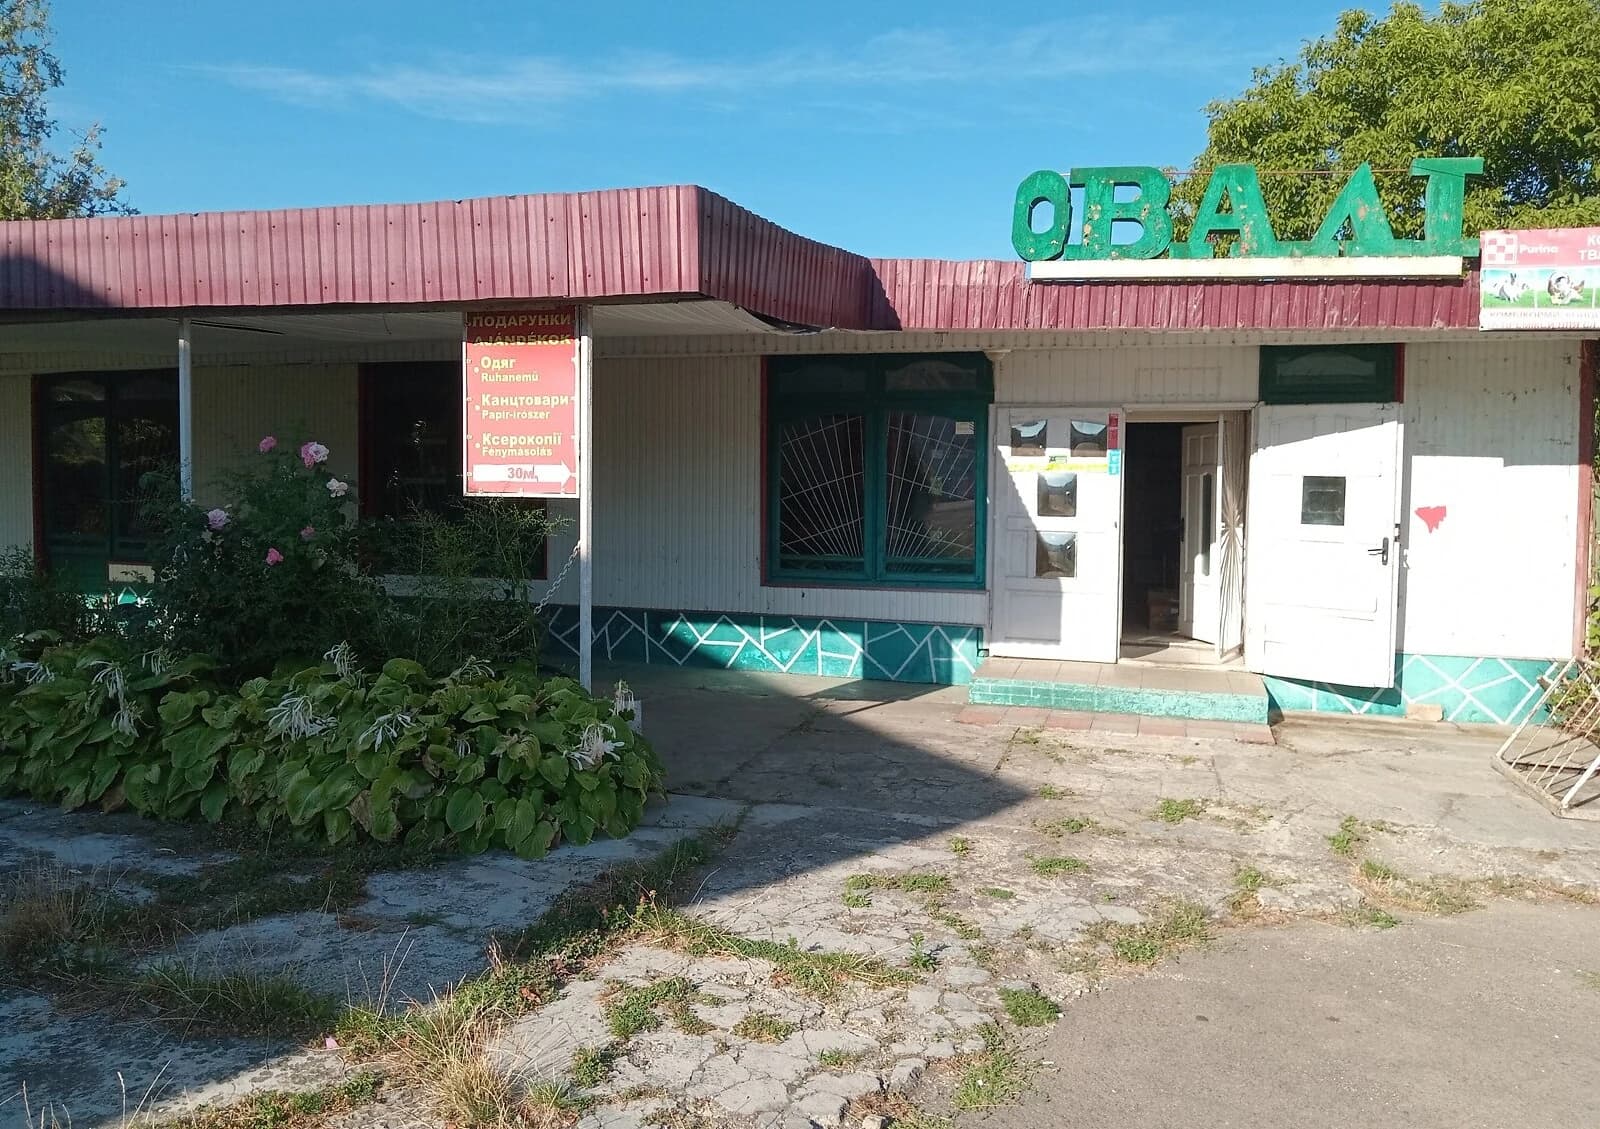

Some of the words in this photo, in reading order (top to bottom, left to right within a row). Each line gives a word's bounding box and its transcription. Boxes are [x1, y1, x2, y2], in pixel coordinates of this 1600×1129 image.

[1578, 249, 1600, 261] ТВ
[472, 313, 571, 329] ПОДАРУНКИ
[473, 332, 571, 346] AJÁNDÉKOK
[480, 356, 516, 370] Одяг
[481, 394, 569, 408] Канцтовари
[482, 433, 562, 448] Ксерокопії
[482, 446, 553, 458] Fénymásolás
